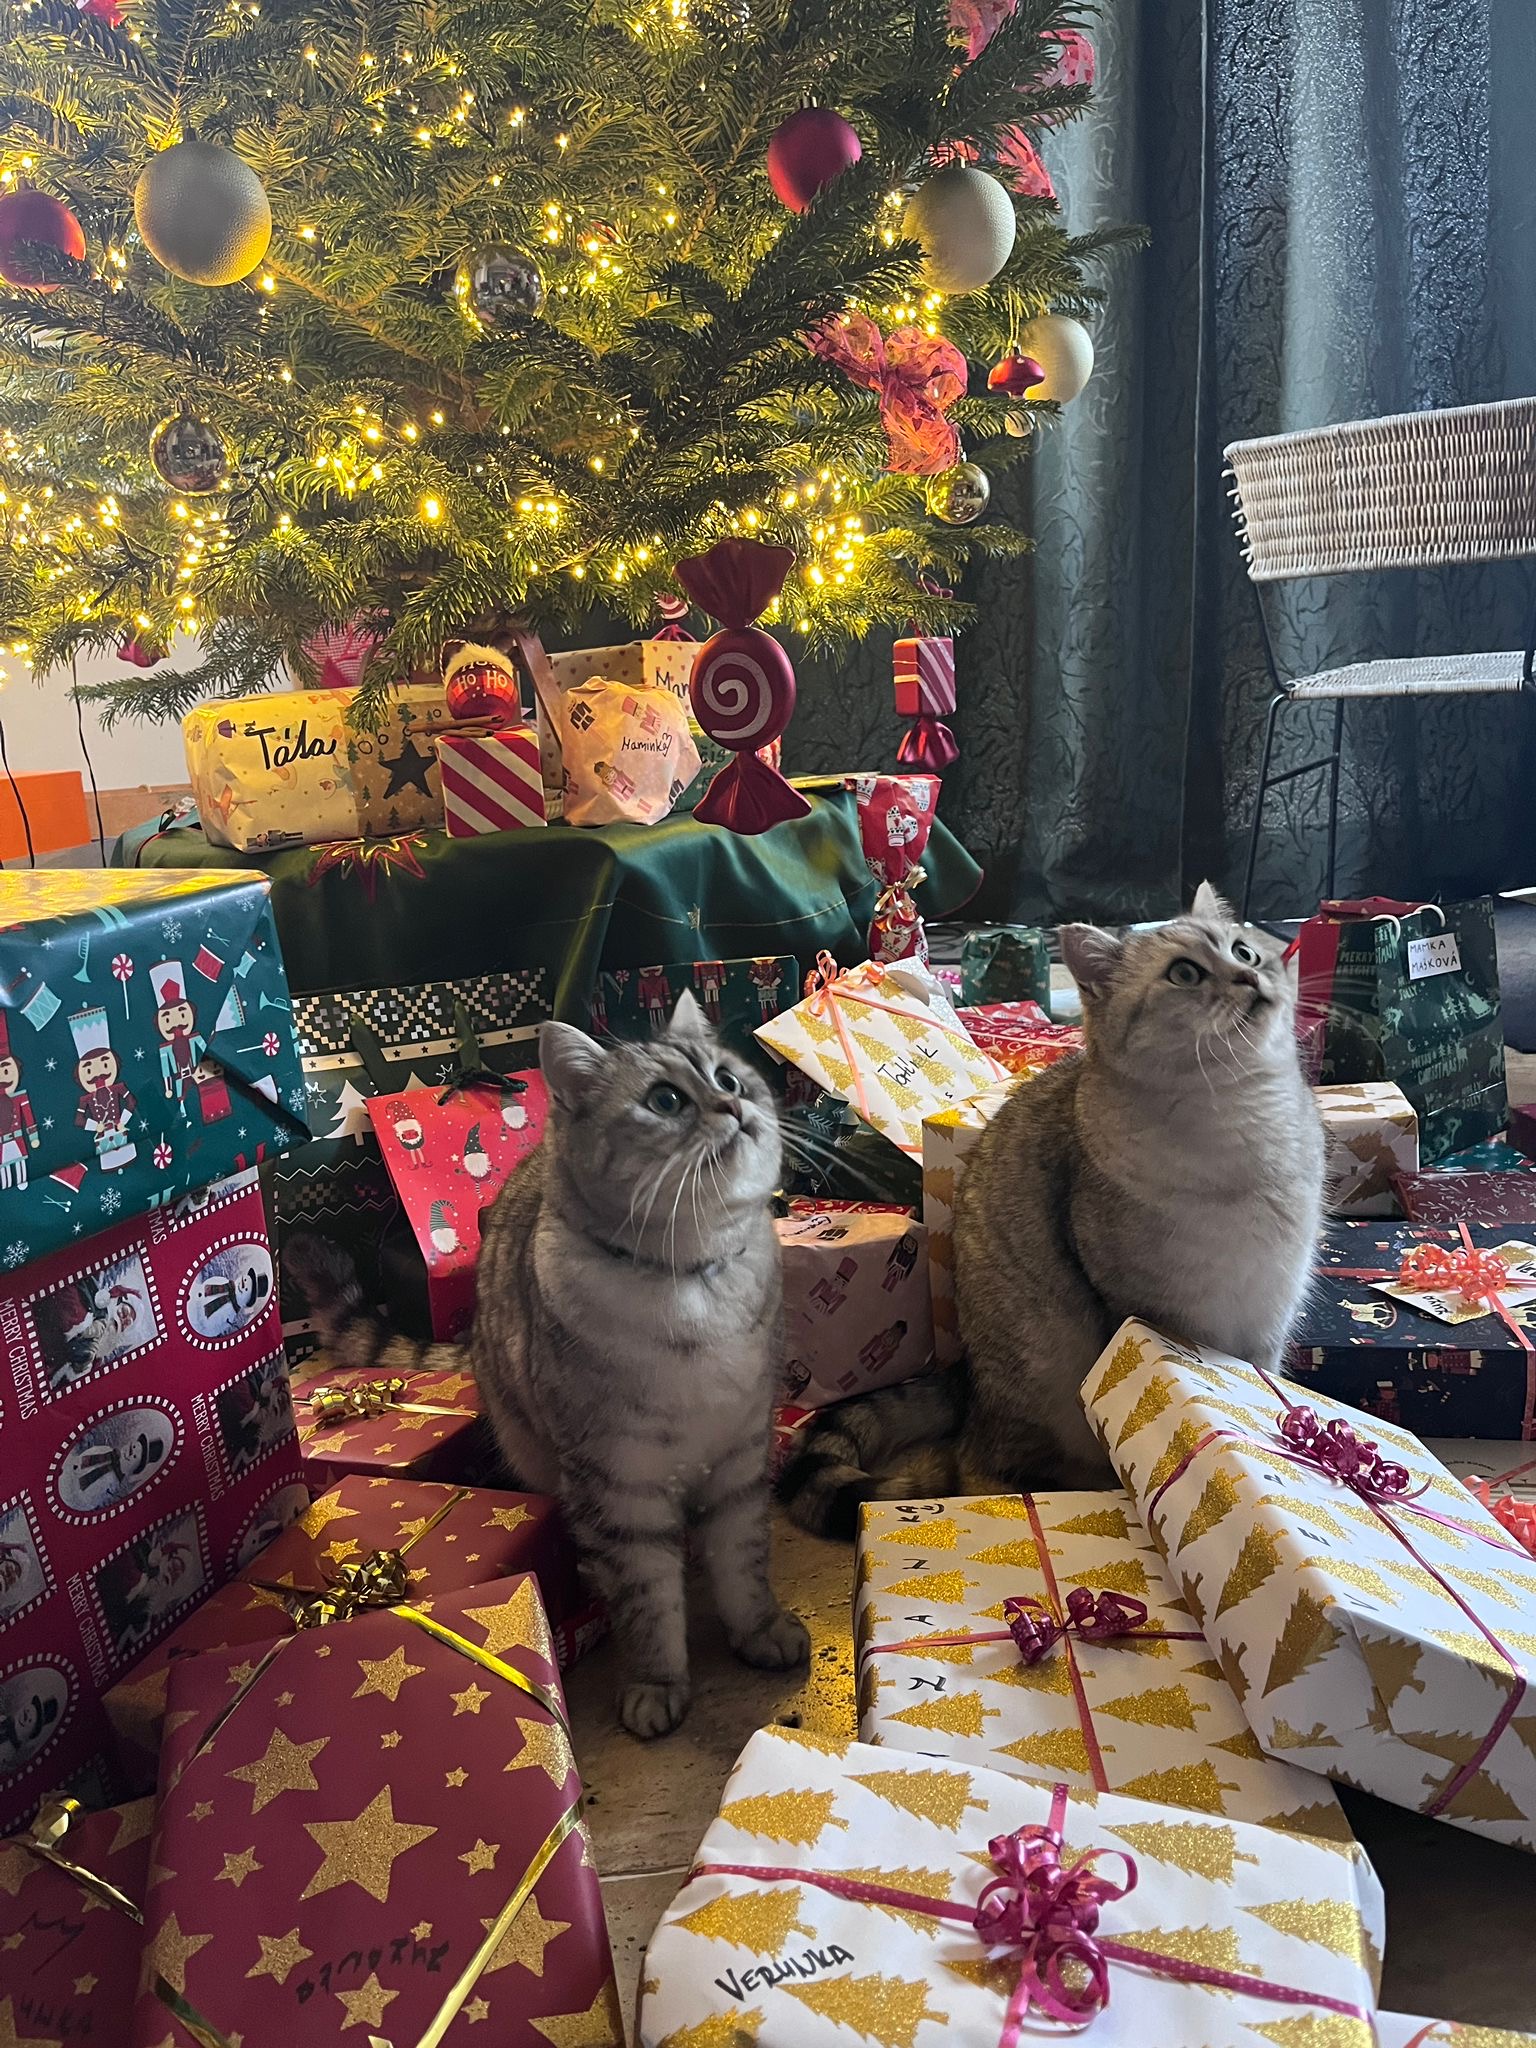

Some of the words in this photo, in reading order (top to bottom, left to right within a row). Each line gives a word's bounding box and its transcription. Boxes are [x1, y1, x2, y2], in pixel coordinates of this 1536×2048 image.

[1410, 940, 1446, 953] MAMKA
[1417, 1057, 1457, 1086] CHRISTMAS
[8, 1345, 39, 1421] CHRISTMAS
[191, 1392, 211, 1435] MERRY
[200, 1435, 225, 1501] CHRISTMAS
[65, 1572, 90, 1618] MERRY
[79, 1616, 110, 1688] CHRISTMAS
[715, 1942, 857, 2003] VERUNKA
